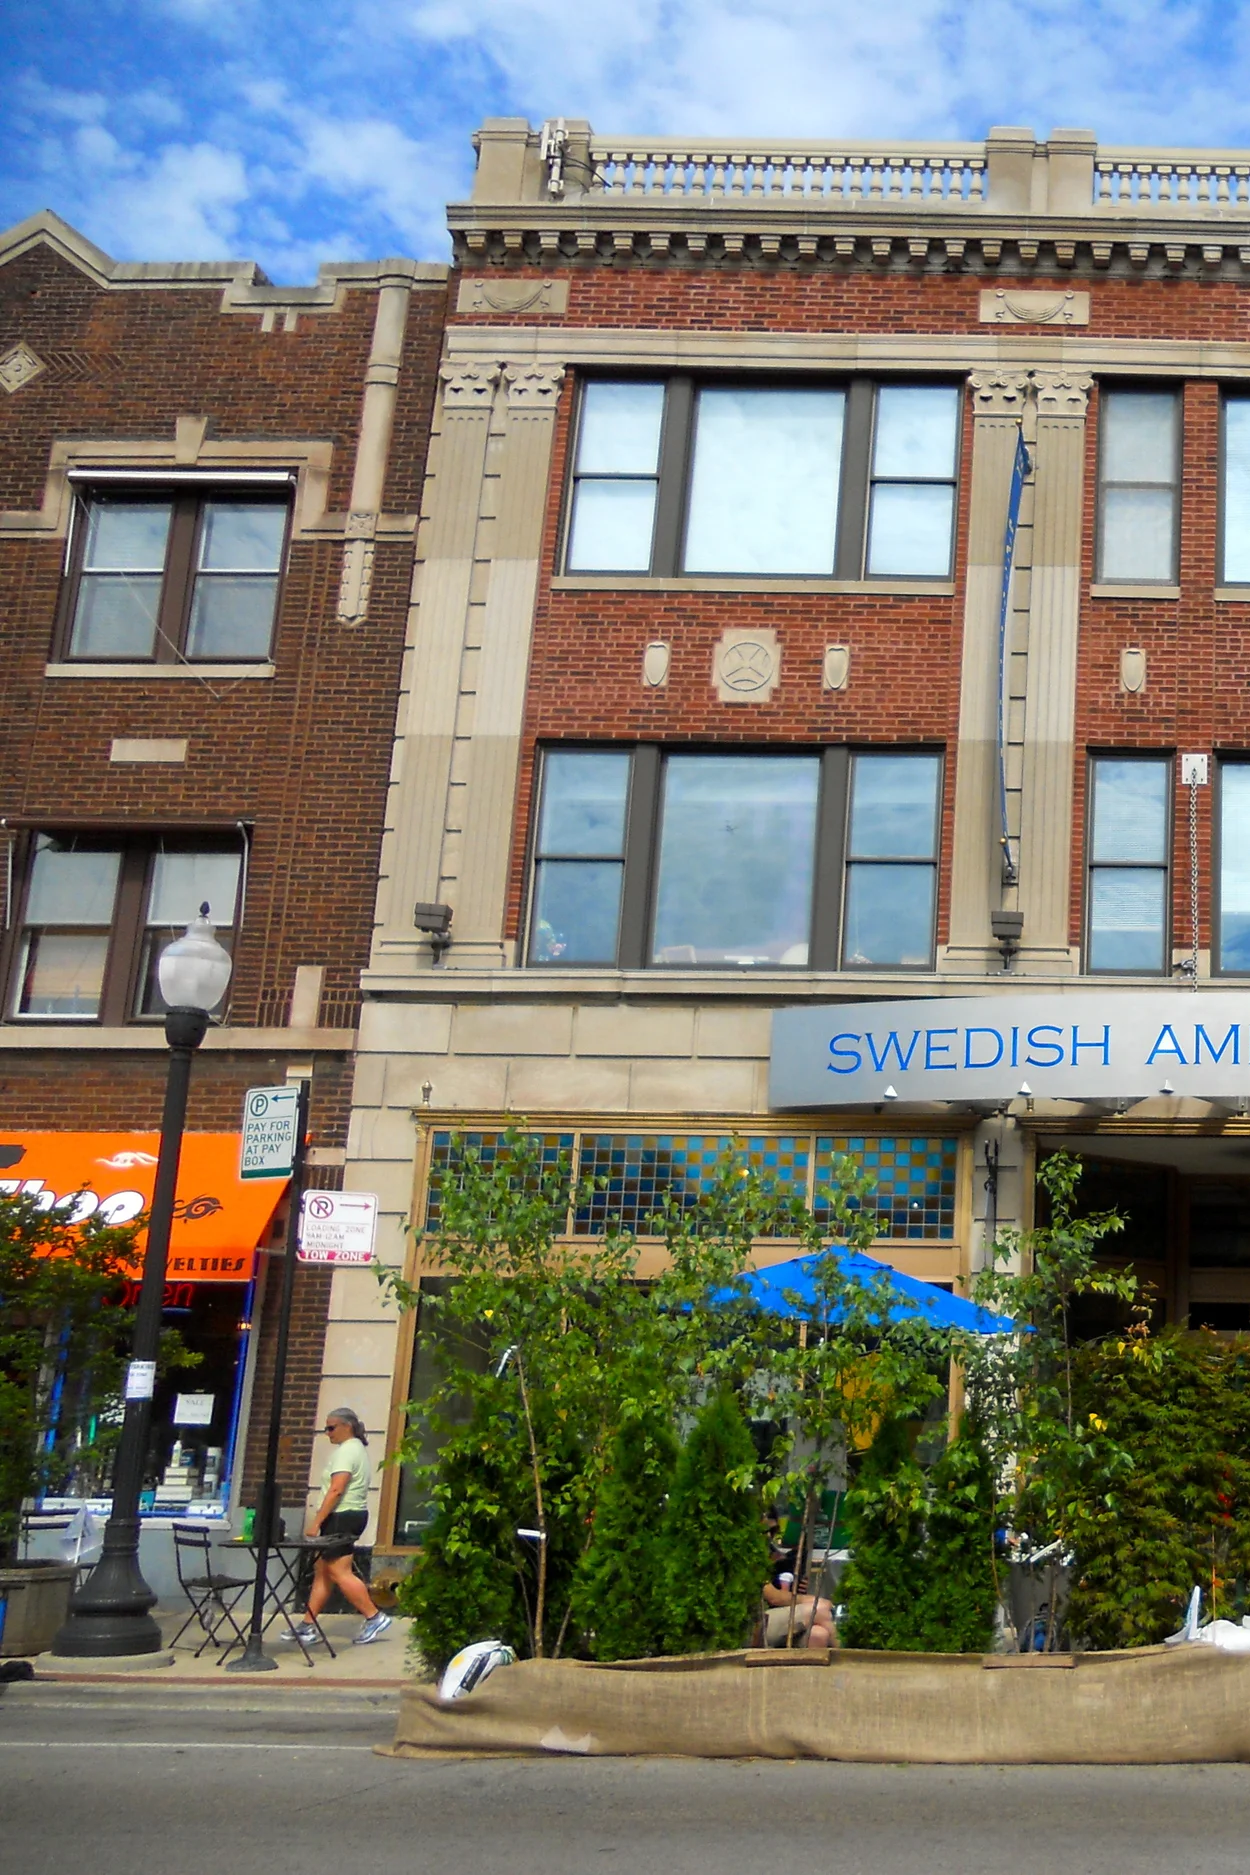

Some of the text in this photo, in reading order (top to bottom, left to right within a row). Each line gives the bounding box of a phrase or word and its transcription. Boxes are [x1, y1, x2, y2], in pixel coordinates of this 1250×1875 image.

[826, 1023, 1112, 1073] SWEDISH
[247, 1120, 290, 1133] PAY FOR
[246, 1131, 291, 1144] PARKING
[246, 1143, 281, 1155] AT PAY
[244, 1155, 265, 1166] BOX
[306, 1224, 366, 1234] LOADING ZONE
[306, 1241, 344, 1249] MIDNIGHT
[304, 1250, 365, 1261] TOW ZONE
